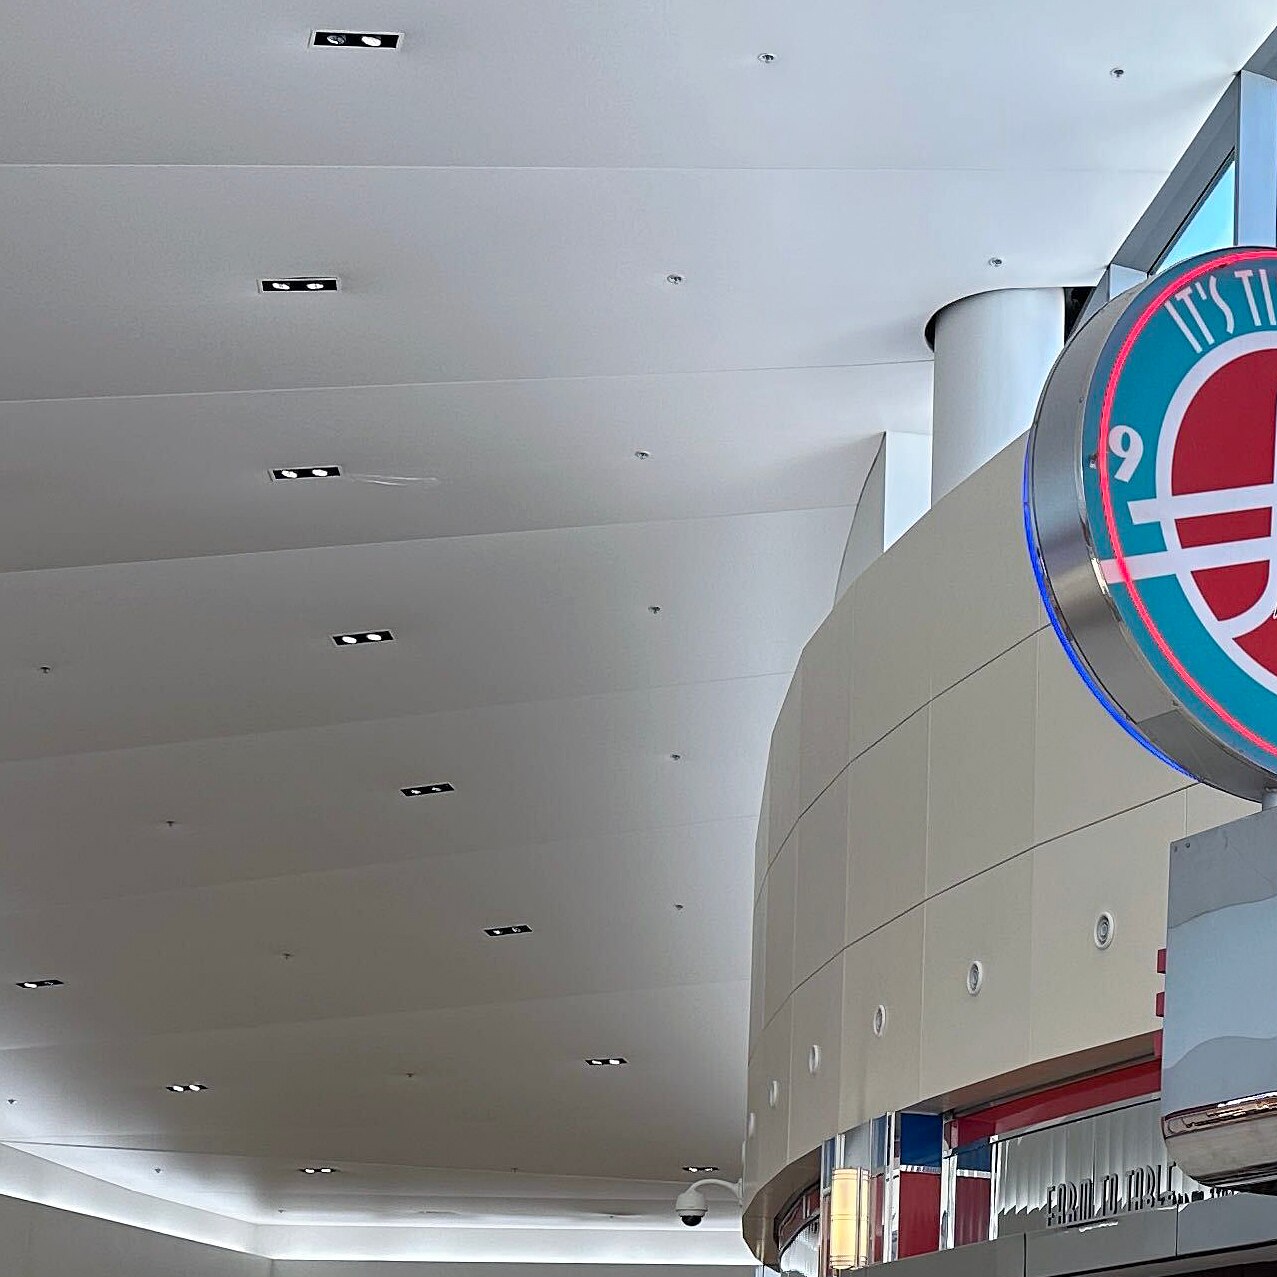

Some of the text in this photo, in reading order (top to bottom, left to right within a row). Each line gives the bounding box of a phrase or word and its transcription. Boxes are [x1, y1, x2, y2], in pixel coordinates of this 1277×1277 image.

[1165, 275, 1235, 354] IT'S
[1107, 424, 1145, 483] 9
[1046, 1179, 1095, 1227] FARM
[1102, 1172, 1119, 1217] TO
